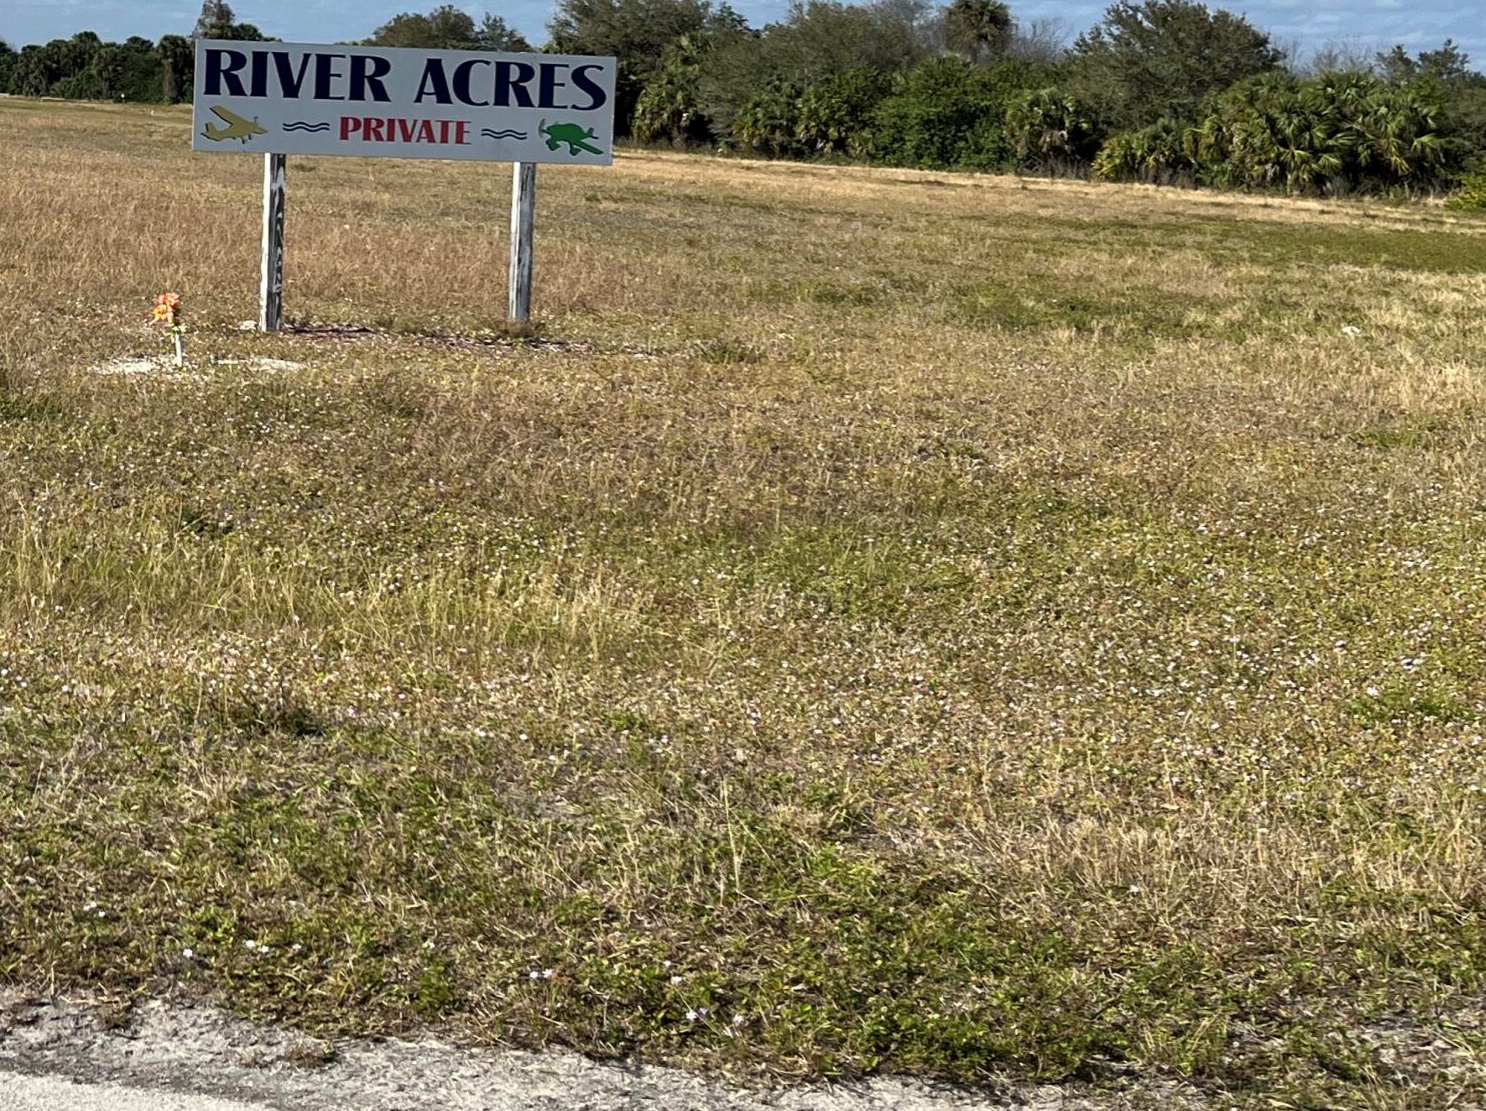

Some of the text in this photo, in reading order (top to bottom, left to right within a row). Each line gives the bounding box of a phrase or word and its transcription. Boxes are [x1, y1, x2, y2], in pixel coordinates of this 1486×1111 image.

[203, 48, 607, 111] RIVER ACRES
[339, 116, 472, 145] PRIVATE
